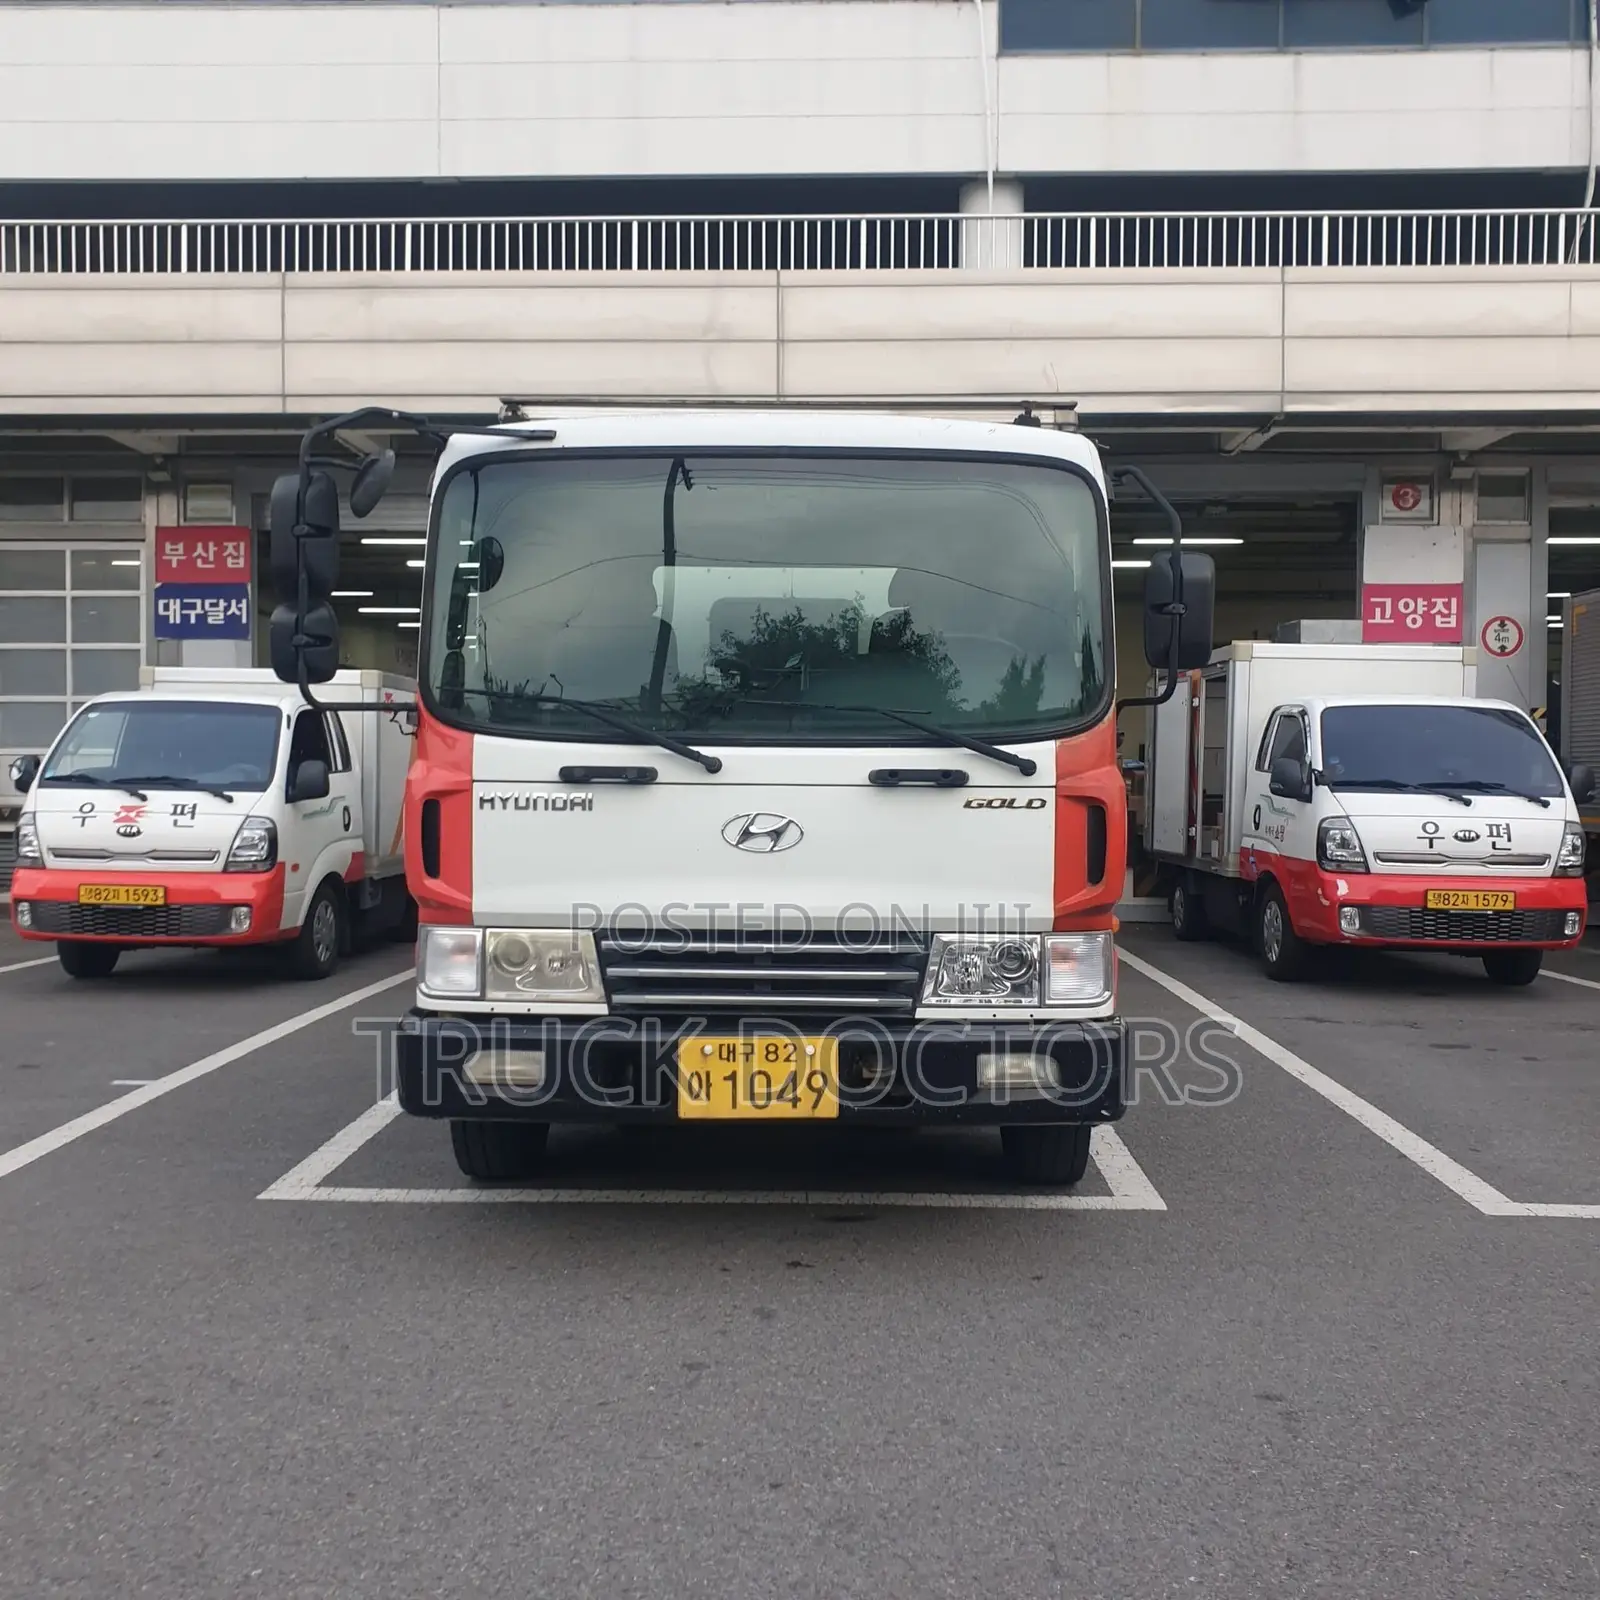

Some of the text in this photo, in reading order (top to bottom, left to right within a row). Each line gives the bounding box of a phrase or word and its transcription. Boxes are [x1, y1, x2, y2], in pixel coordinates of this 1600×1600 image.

[1399, 488, 1414, 508] 3
[162, 541, 245, 568] 부산집
[158, 598, 247, 624] 대구달서
[1367, 597, 1457, 629] 고양집
[479, 791, 593, 811] HYUNDAI
[963, 798, 1047, 809] GOLD
[1455, 830, 1479, 842] KIA
[124, 888, 158, 902] 1593
[1473, 894, 1509, 907] 1579
[718, 1043, 798, 1063] 대구 82
[723, 1069, 829, 1110] 1049
